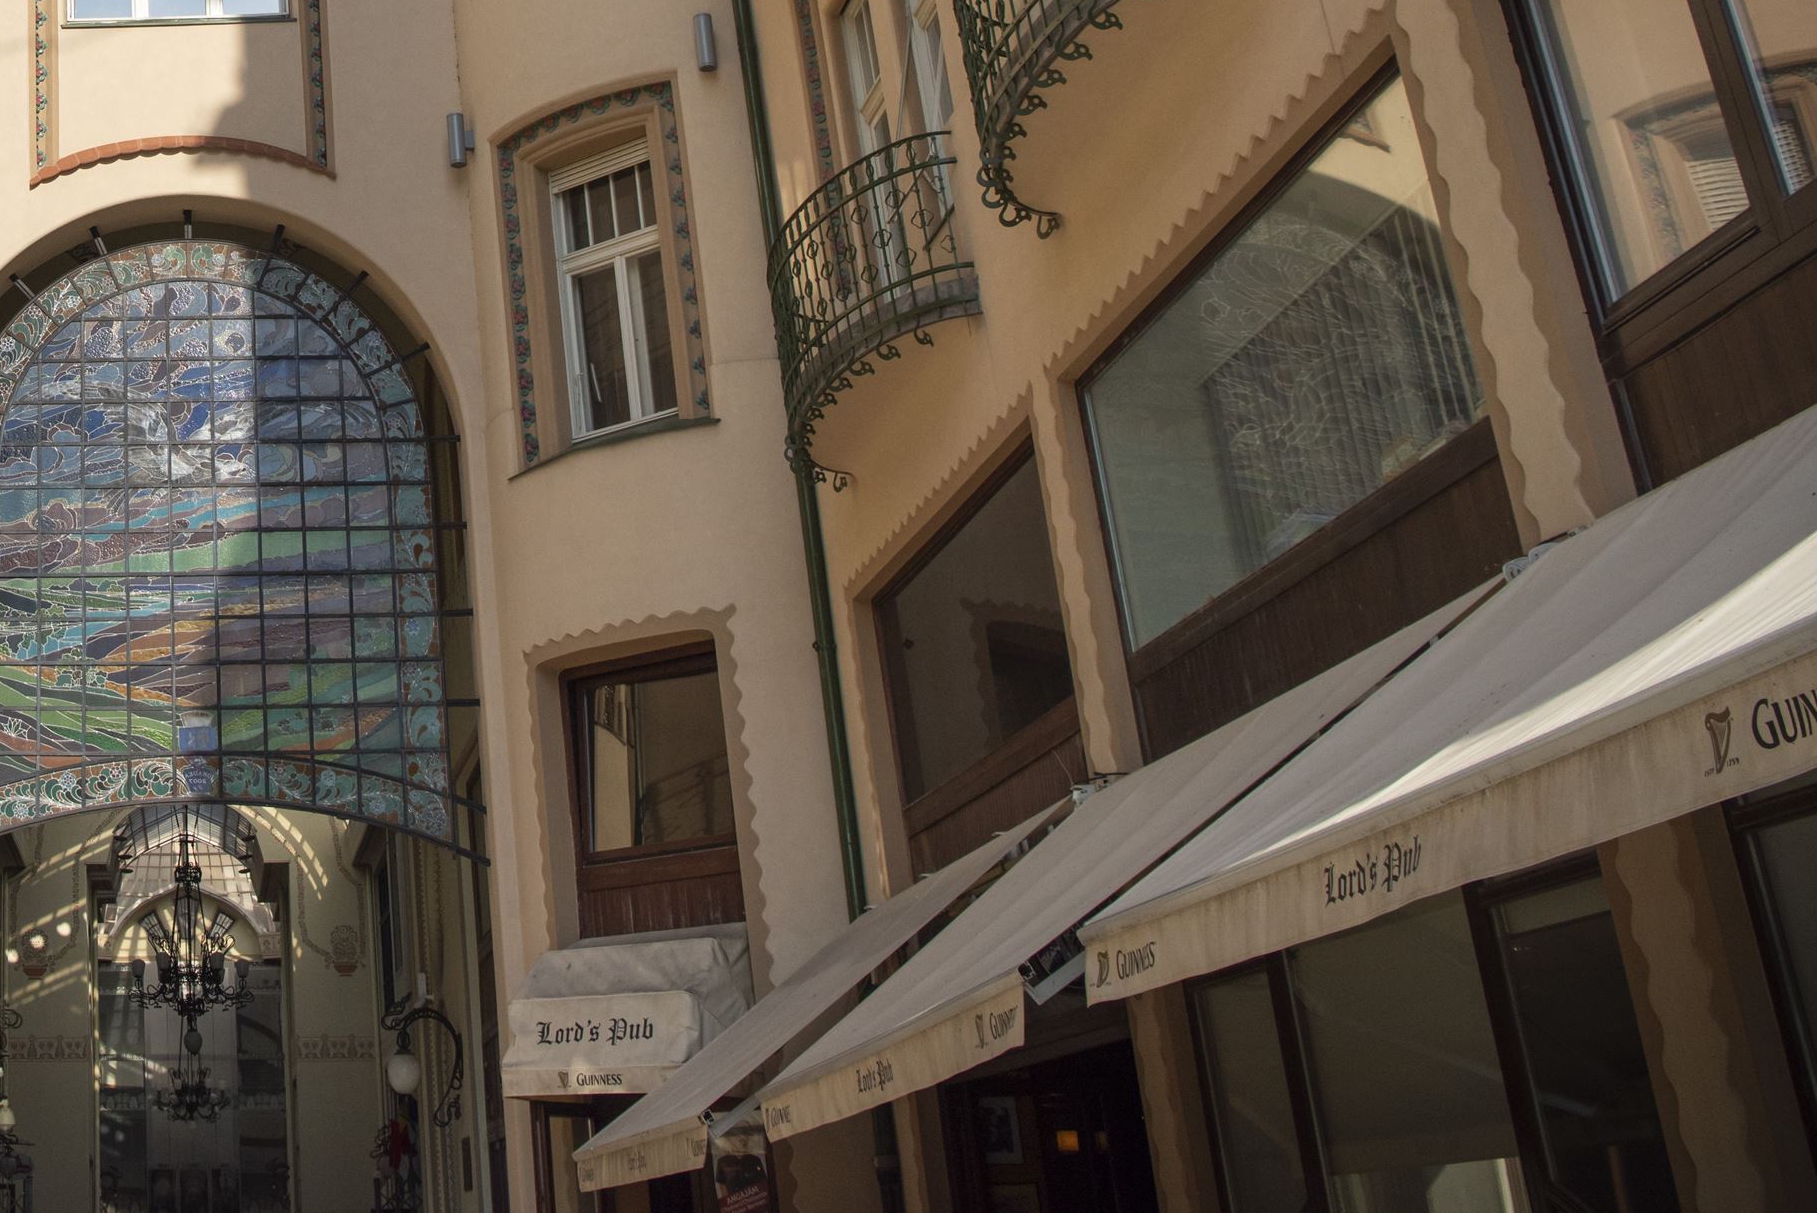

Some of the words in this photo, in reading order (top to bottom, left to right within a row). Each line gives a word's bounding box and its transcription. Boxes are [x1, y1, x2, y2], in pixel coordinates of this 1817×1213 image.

[1324, 852, 1379, 907] Lord's
[1381, 835, 1421, 892] Pub
[535, 1019, 601, 1045] Lord's
[606, 1017, 654, 1046] Pub
[576, 1072, 622, 1086] GUINNESS
